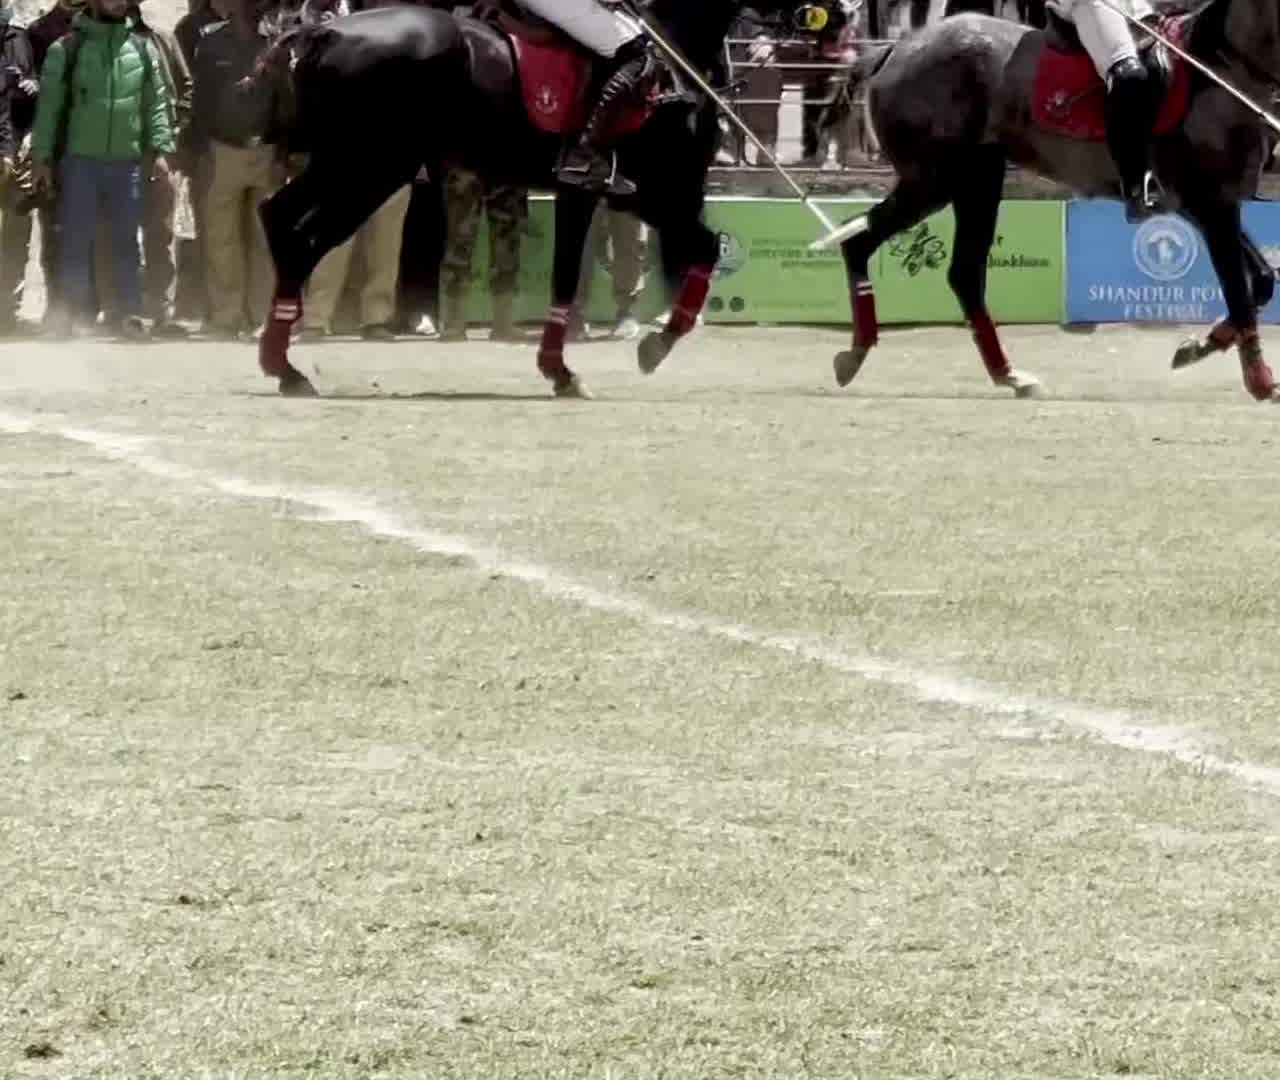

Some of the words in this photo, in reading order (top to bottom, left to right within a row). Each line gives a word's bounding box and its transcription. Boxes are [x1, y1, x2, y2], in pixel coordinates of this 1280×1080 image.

[1088, 285, 1185, 303] SHANDUR
[1190, 286, 1225, 303] POL
[1123, 304, 1208, 321] FESTIVAL
